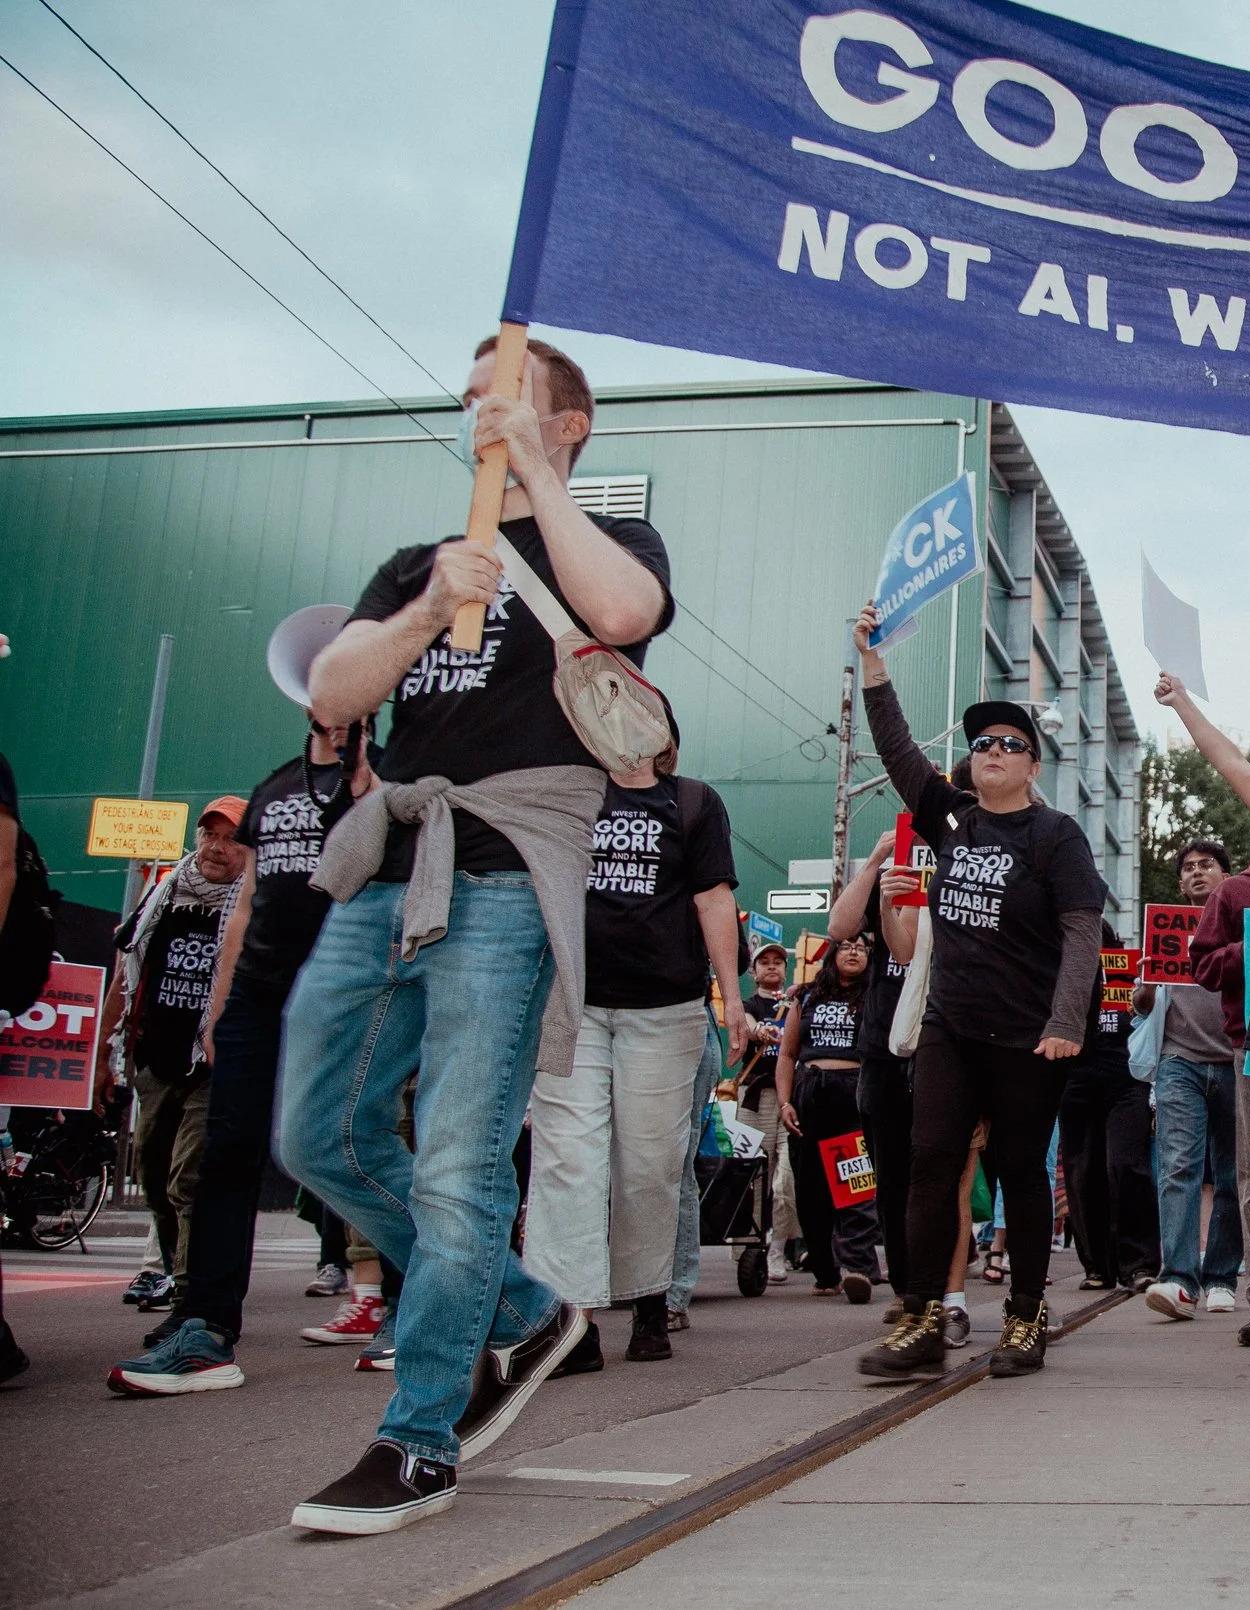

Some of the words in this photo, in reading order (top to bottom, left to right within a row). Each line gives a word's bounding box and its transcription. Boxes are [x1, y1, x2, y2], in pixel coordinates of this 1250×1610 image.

[777, 202, 992, 301] NOT
[875, 542, 967, 626] BILLIONAIRES
[260, 809, 324, 833] WORK
[611, 810, 638, 818] INVEST
[113, 823, 133, 833] YOUR
[137, 824, 164, 836] SIGNAL
[594, 818, 663, 835] GOOD
[95, 836, 110, 849] TWO
[114, 838, 137, 850] STAGE
[141, 840, 178, 852] CROSSING
[593, 833, 661, 853] WORK
[612, 852, 629, 860] AND
[953, 845, 1014, 871] GOOD
[949, 860, 1009, 887] WORK
[586, 877, 656, 896] FUTURE
[960, 882, 977, 891] AND
[940, 888, 1002, 915] LIVABLE
[938, 905, 1000, 931] FUTURE
[170, 938, 217, 957] GOO
[1152, 935, 1181, 956] IS
[167, 952, 213, 973] WOR
[887, 964, 911, 978] FUT
[1100, 955, 1127, 969] LINES
[161, 977, 211, 996] LIVABL
[1102, 989, 1132, 1002] PLANE
[158, 991, 210, 1011] FUTUR
[815, 1004, 856, 1015] GOO
[812, 1013, 856, 1025] WORK
[0, 1034, 89, 1053] ELCOME
[810, 1029, 854, 1040] LIVABLE
[1, 1053, 86, 1082] ERE
